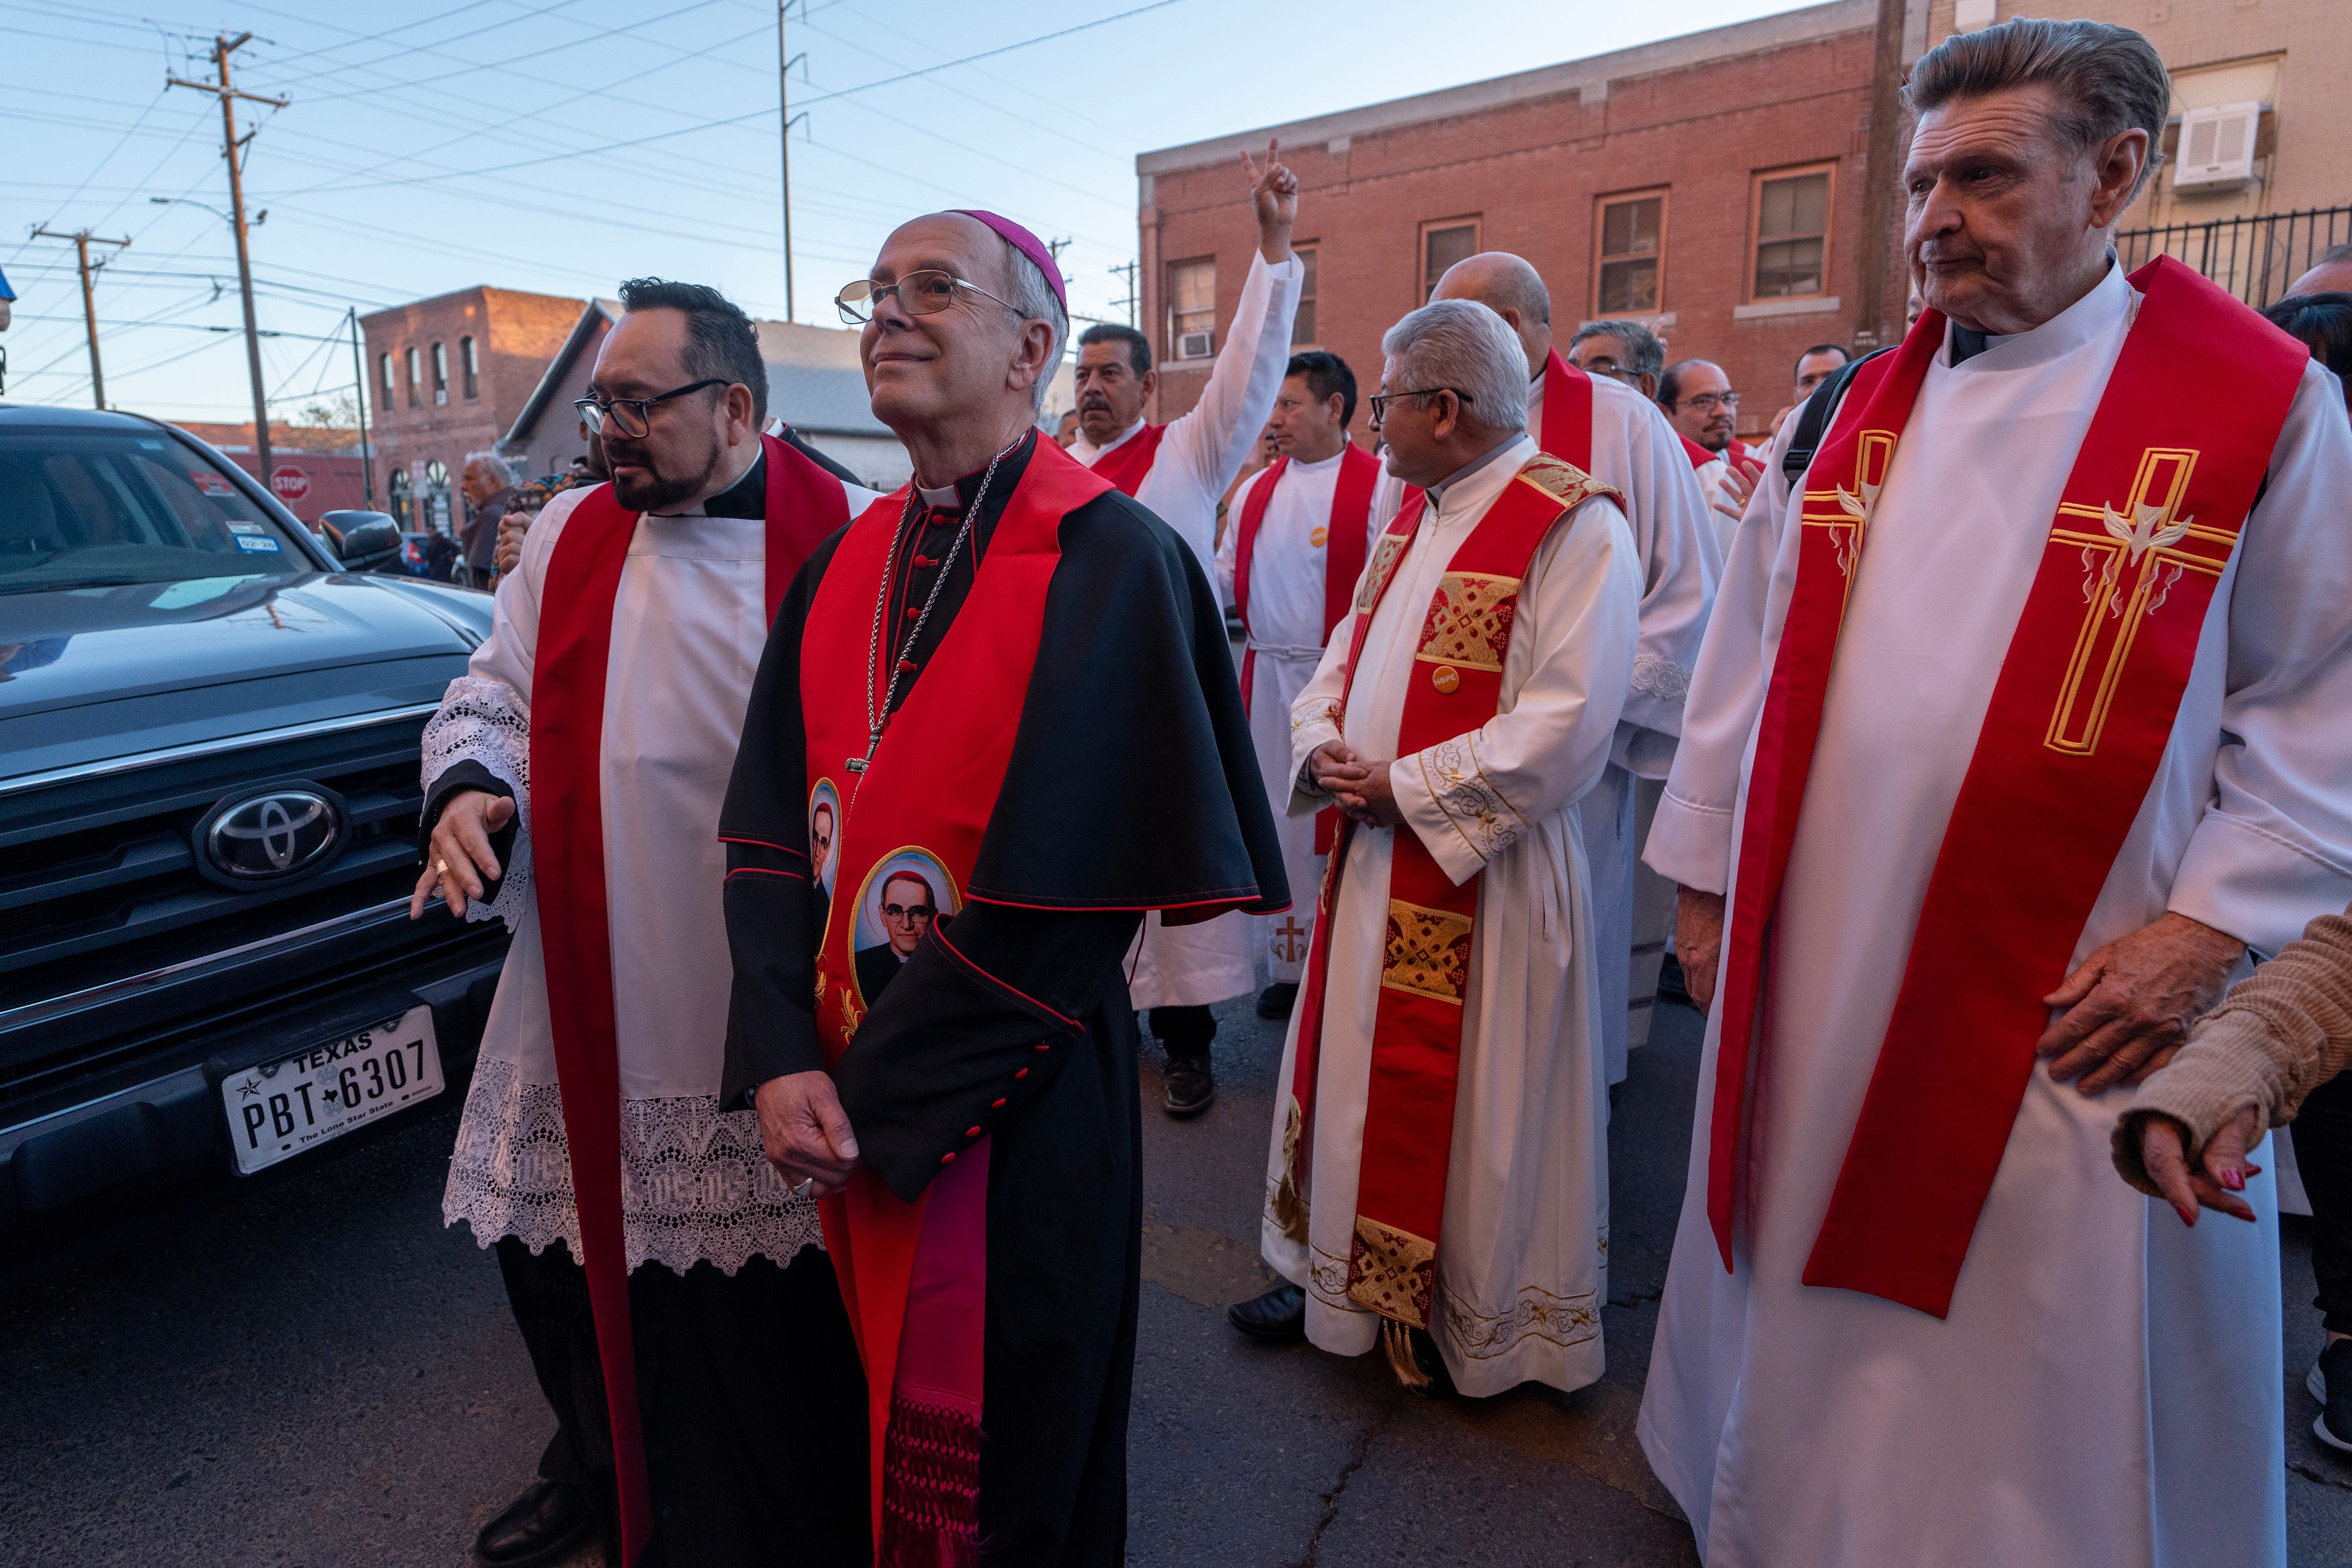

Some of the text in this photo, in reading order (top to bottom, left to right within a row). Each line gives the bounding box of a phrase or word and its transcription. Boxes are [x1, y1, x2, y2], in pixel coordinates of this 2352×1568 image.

[274, 476, 306, 491] STOP
[1433, 673, 1456, 686] HOPE
[292, 1032, 372, 1074] TEXAS
[242, 1039, 424, 1149] PBT 6307
[299, 1101, 393, 1143] The Lone Star State
